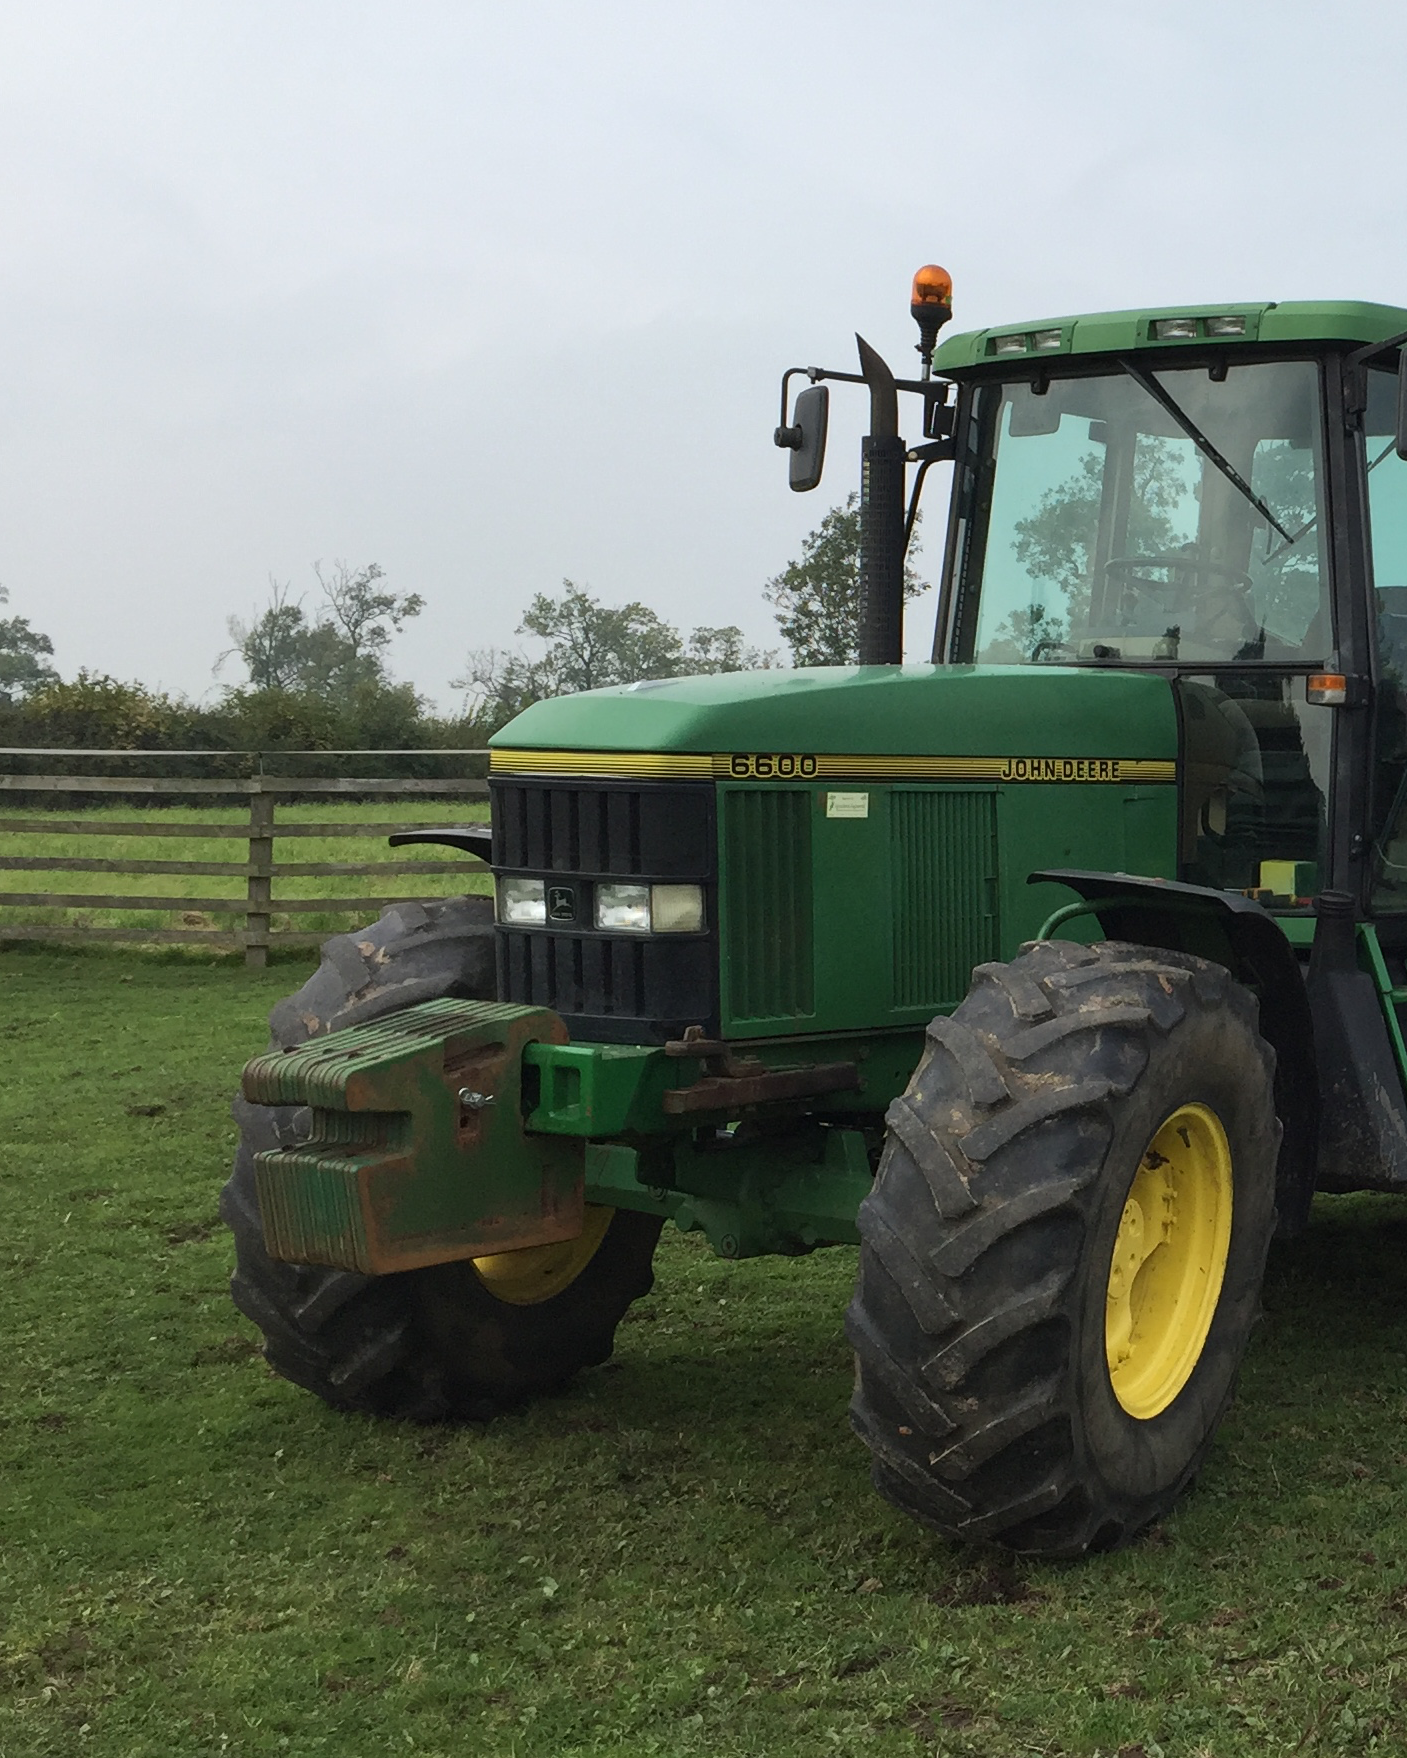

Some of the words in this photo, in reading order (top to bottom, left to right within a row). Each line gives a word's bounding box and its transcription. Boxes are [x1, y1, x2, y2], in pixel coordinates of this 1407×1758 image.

[731, 753, 818, 778] 6600
[1001, 758, 1057, 780] JOHN
[1062, 759, 1120, 781] DEERE
